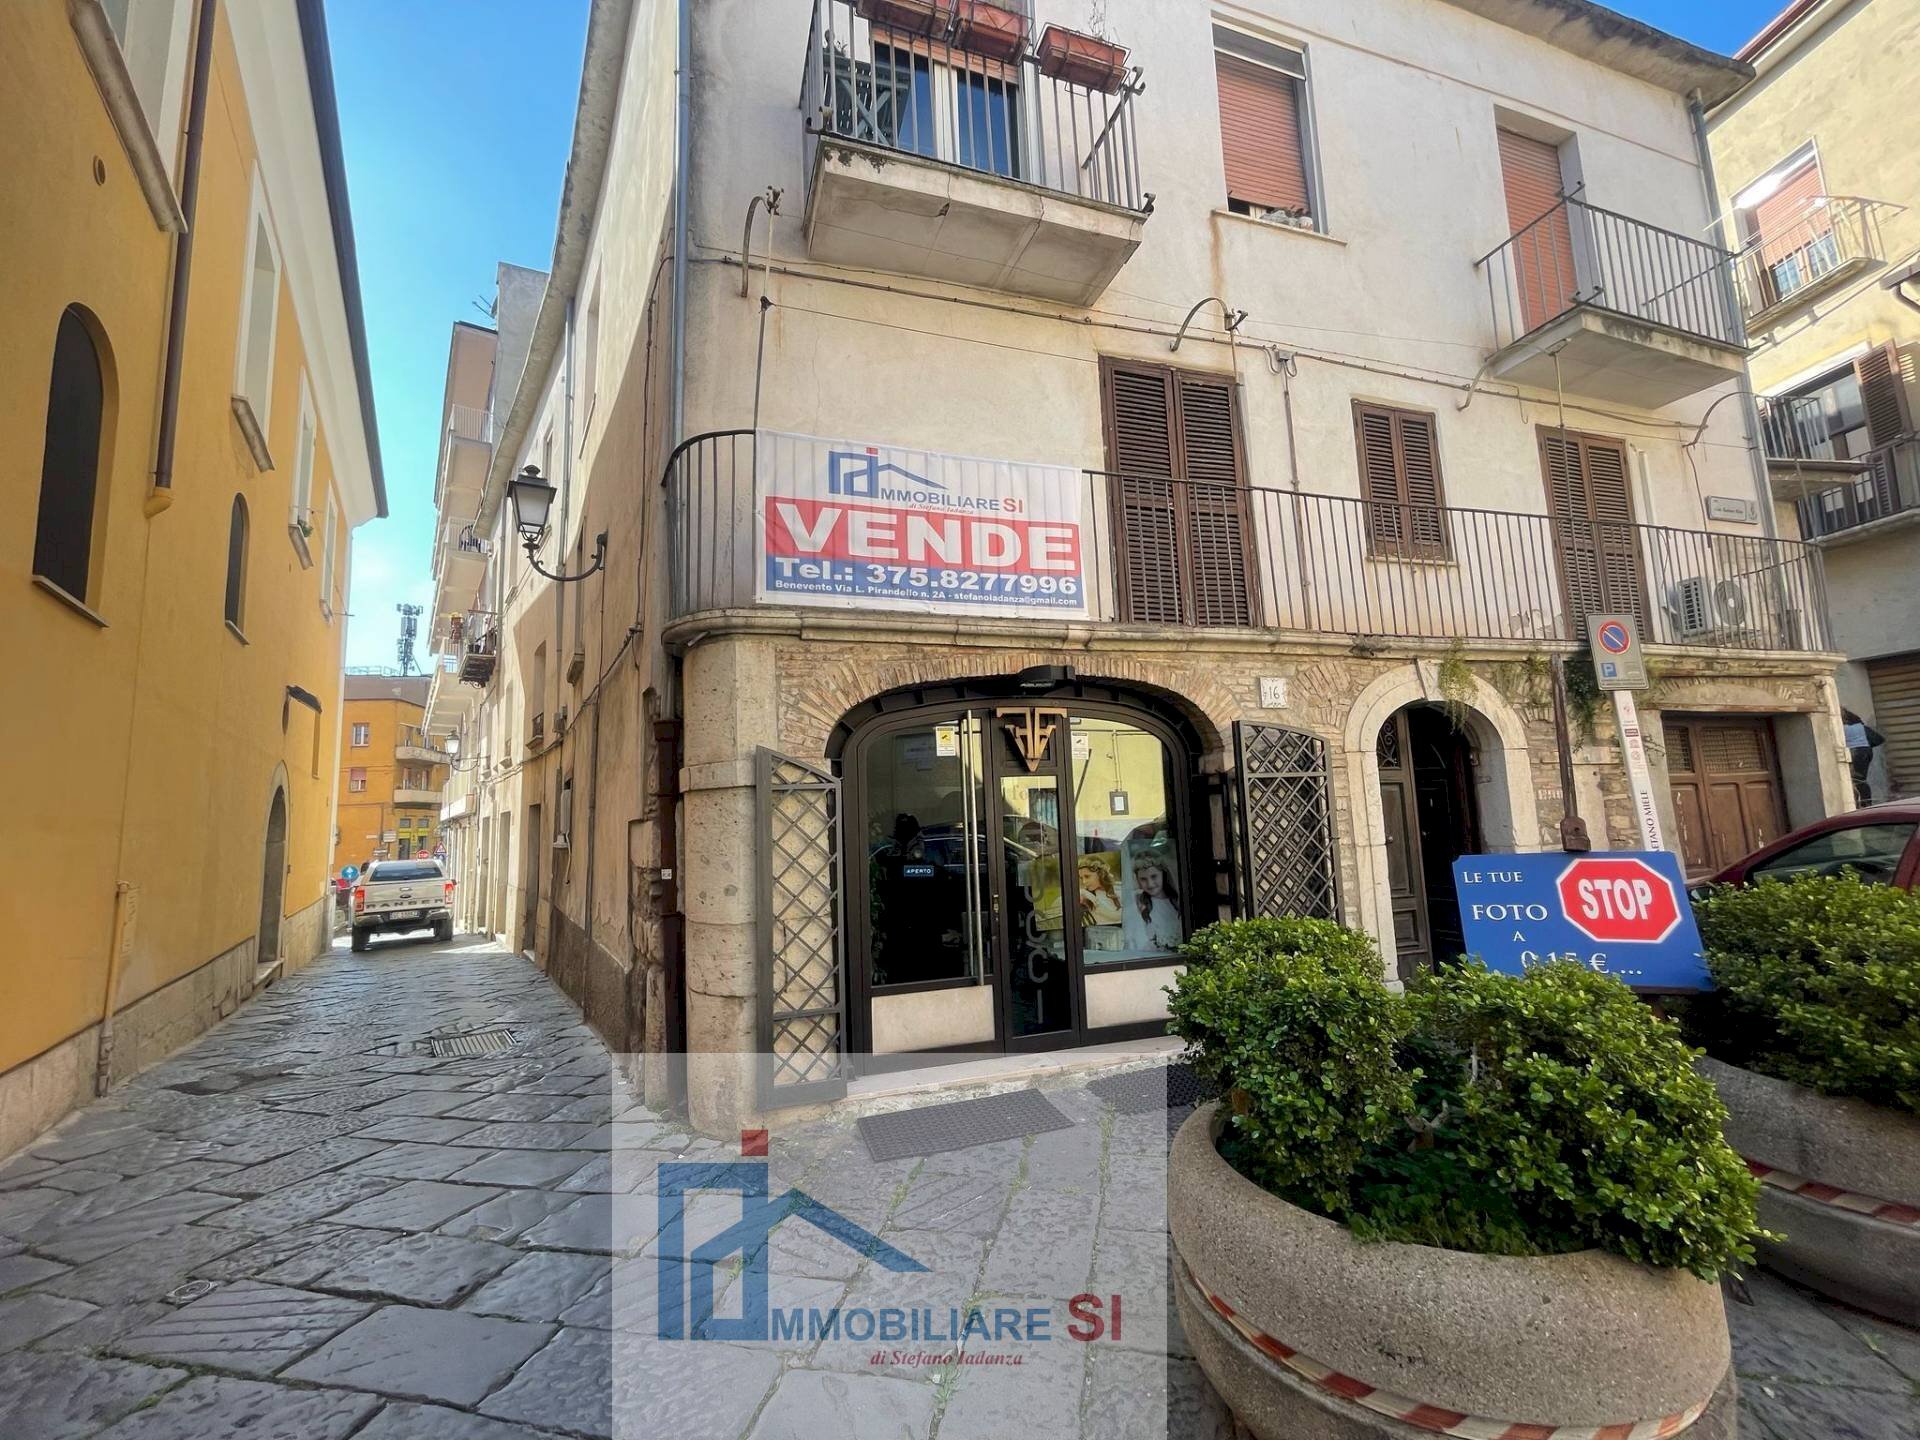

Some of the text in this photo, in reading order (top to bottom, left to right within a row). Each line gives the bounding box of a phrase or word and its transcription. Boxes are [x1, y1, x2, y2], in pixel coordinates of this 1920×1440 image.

[1003, 498, 1023, 513] SI
[775, 503, 1076, 571] VENDE
[775, 557, 1077, 595] Tel.: 375.8277996
[775, 580, 832, 592] Benevento
[835, 584, 852, 593] Via
[868, 586, 918, 597] Pirandello
[932, 591, 946, 599] 2A
[1269, 686, 1280, 699] 16
[1640, 790, 1652, 815] MIELE
[1646, 818, 1660, 852] ETANO
[1487, 871, 1523, 883] TUE
[1578, 878, 1652, 921] STOP
[1472, 904, 1548, 921] FOTO
[1513, 931, 1526, 942] A
